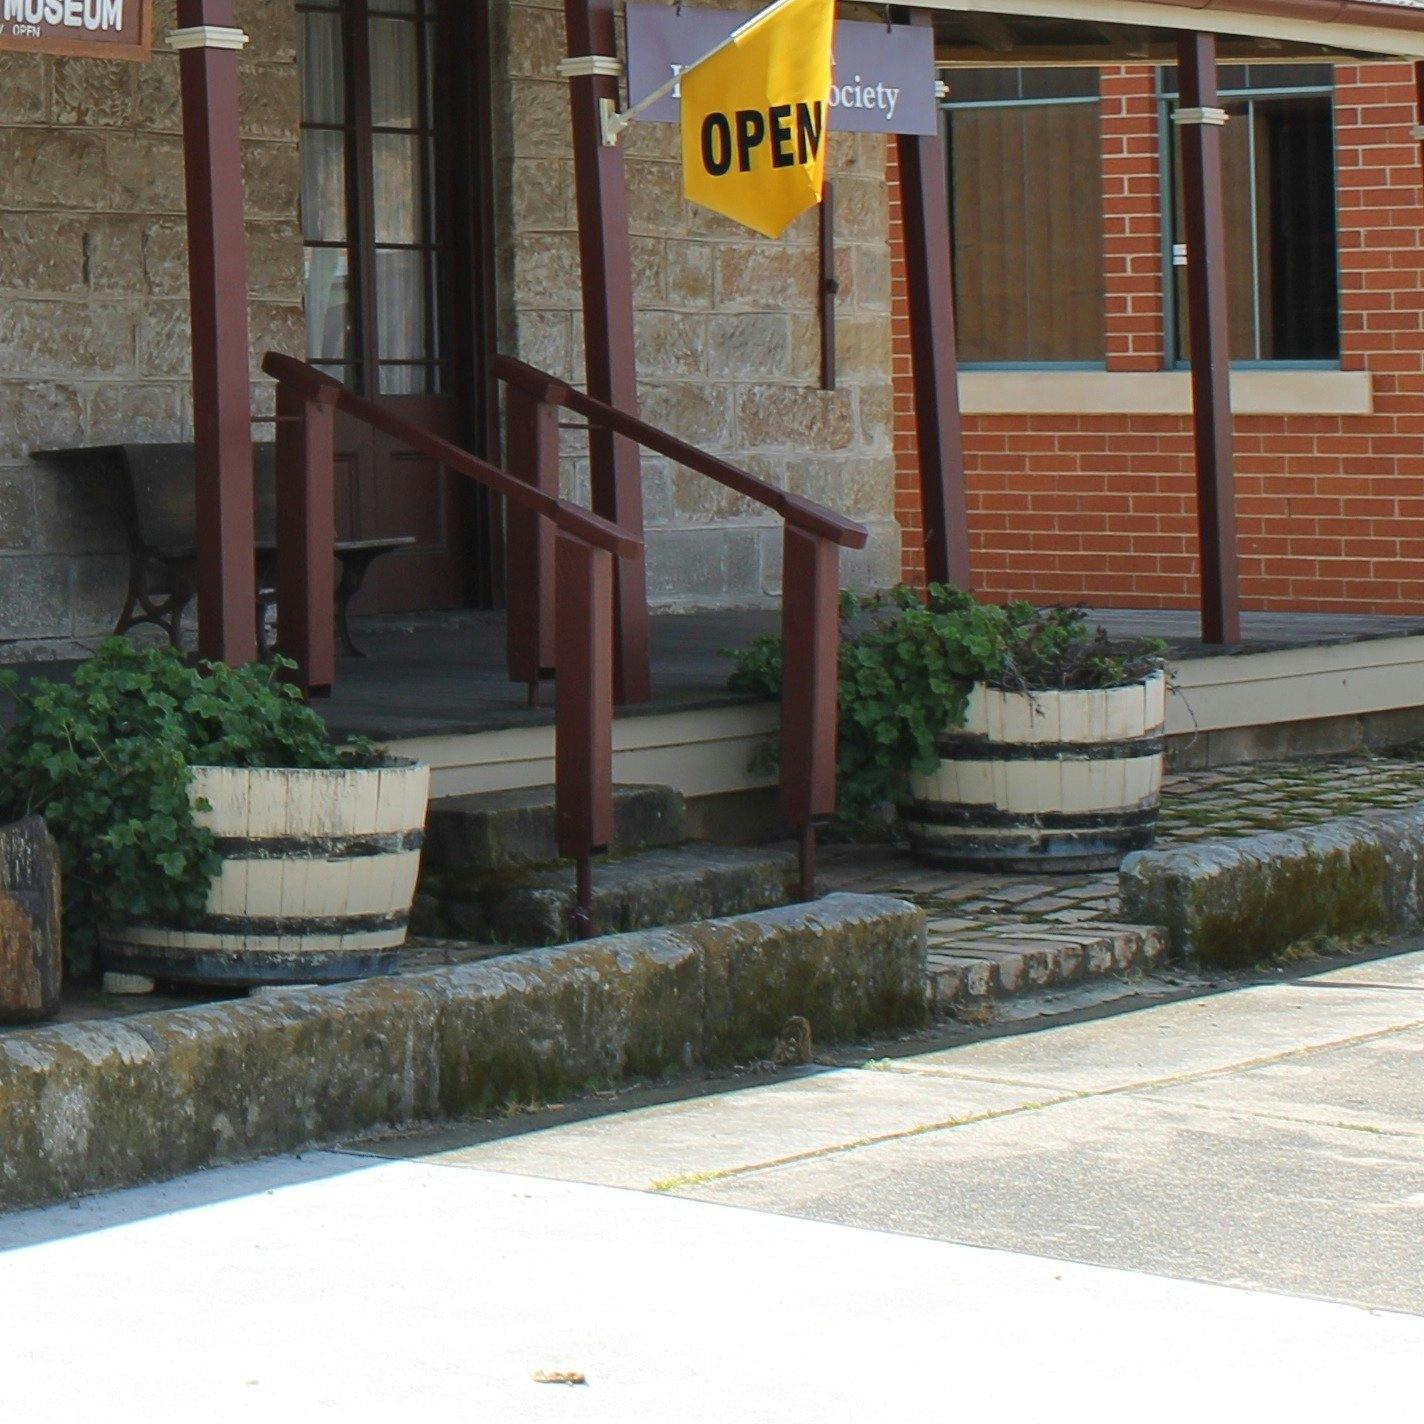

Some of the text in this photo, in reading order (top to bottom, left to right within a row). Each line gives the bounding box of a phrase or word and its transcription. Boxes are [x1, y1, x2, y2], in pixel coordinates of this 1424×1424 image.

[12, 24, 41, 37] OPEN
[829, 75, 900, 120] ociety
[701, 101, 822, 176] OPEN
